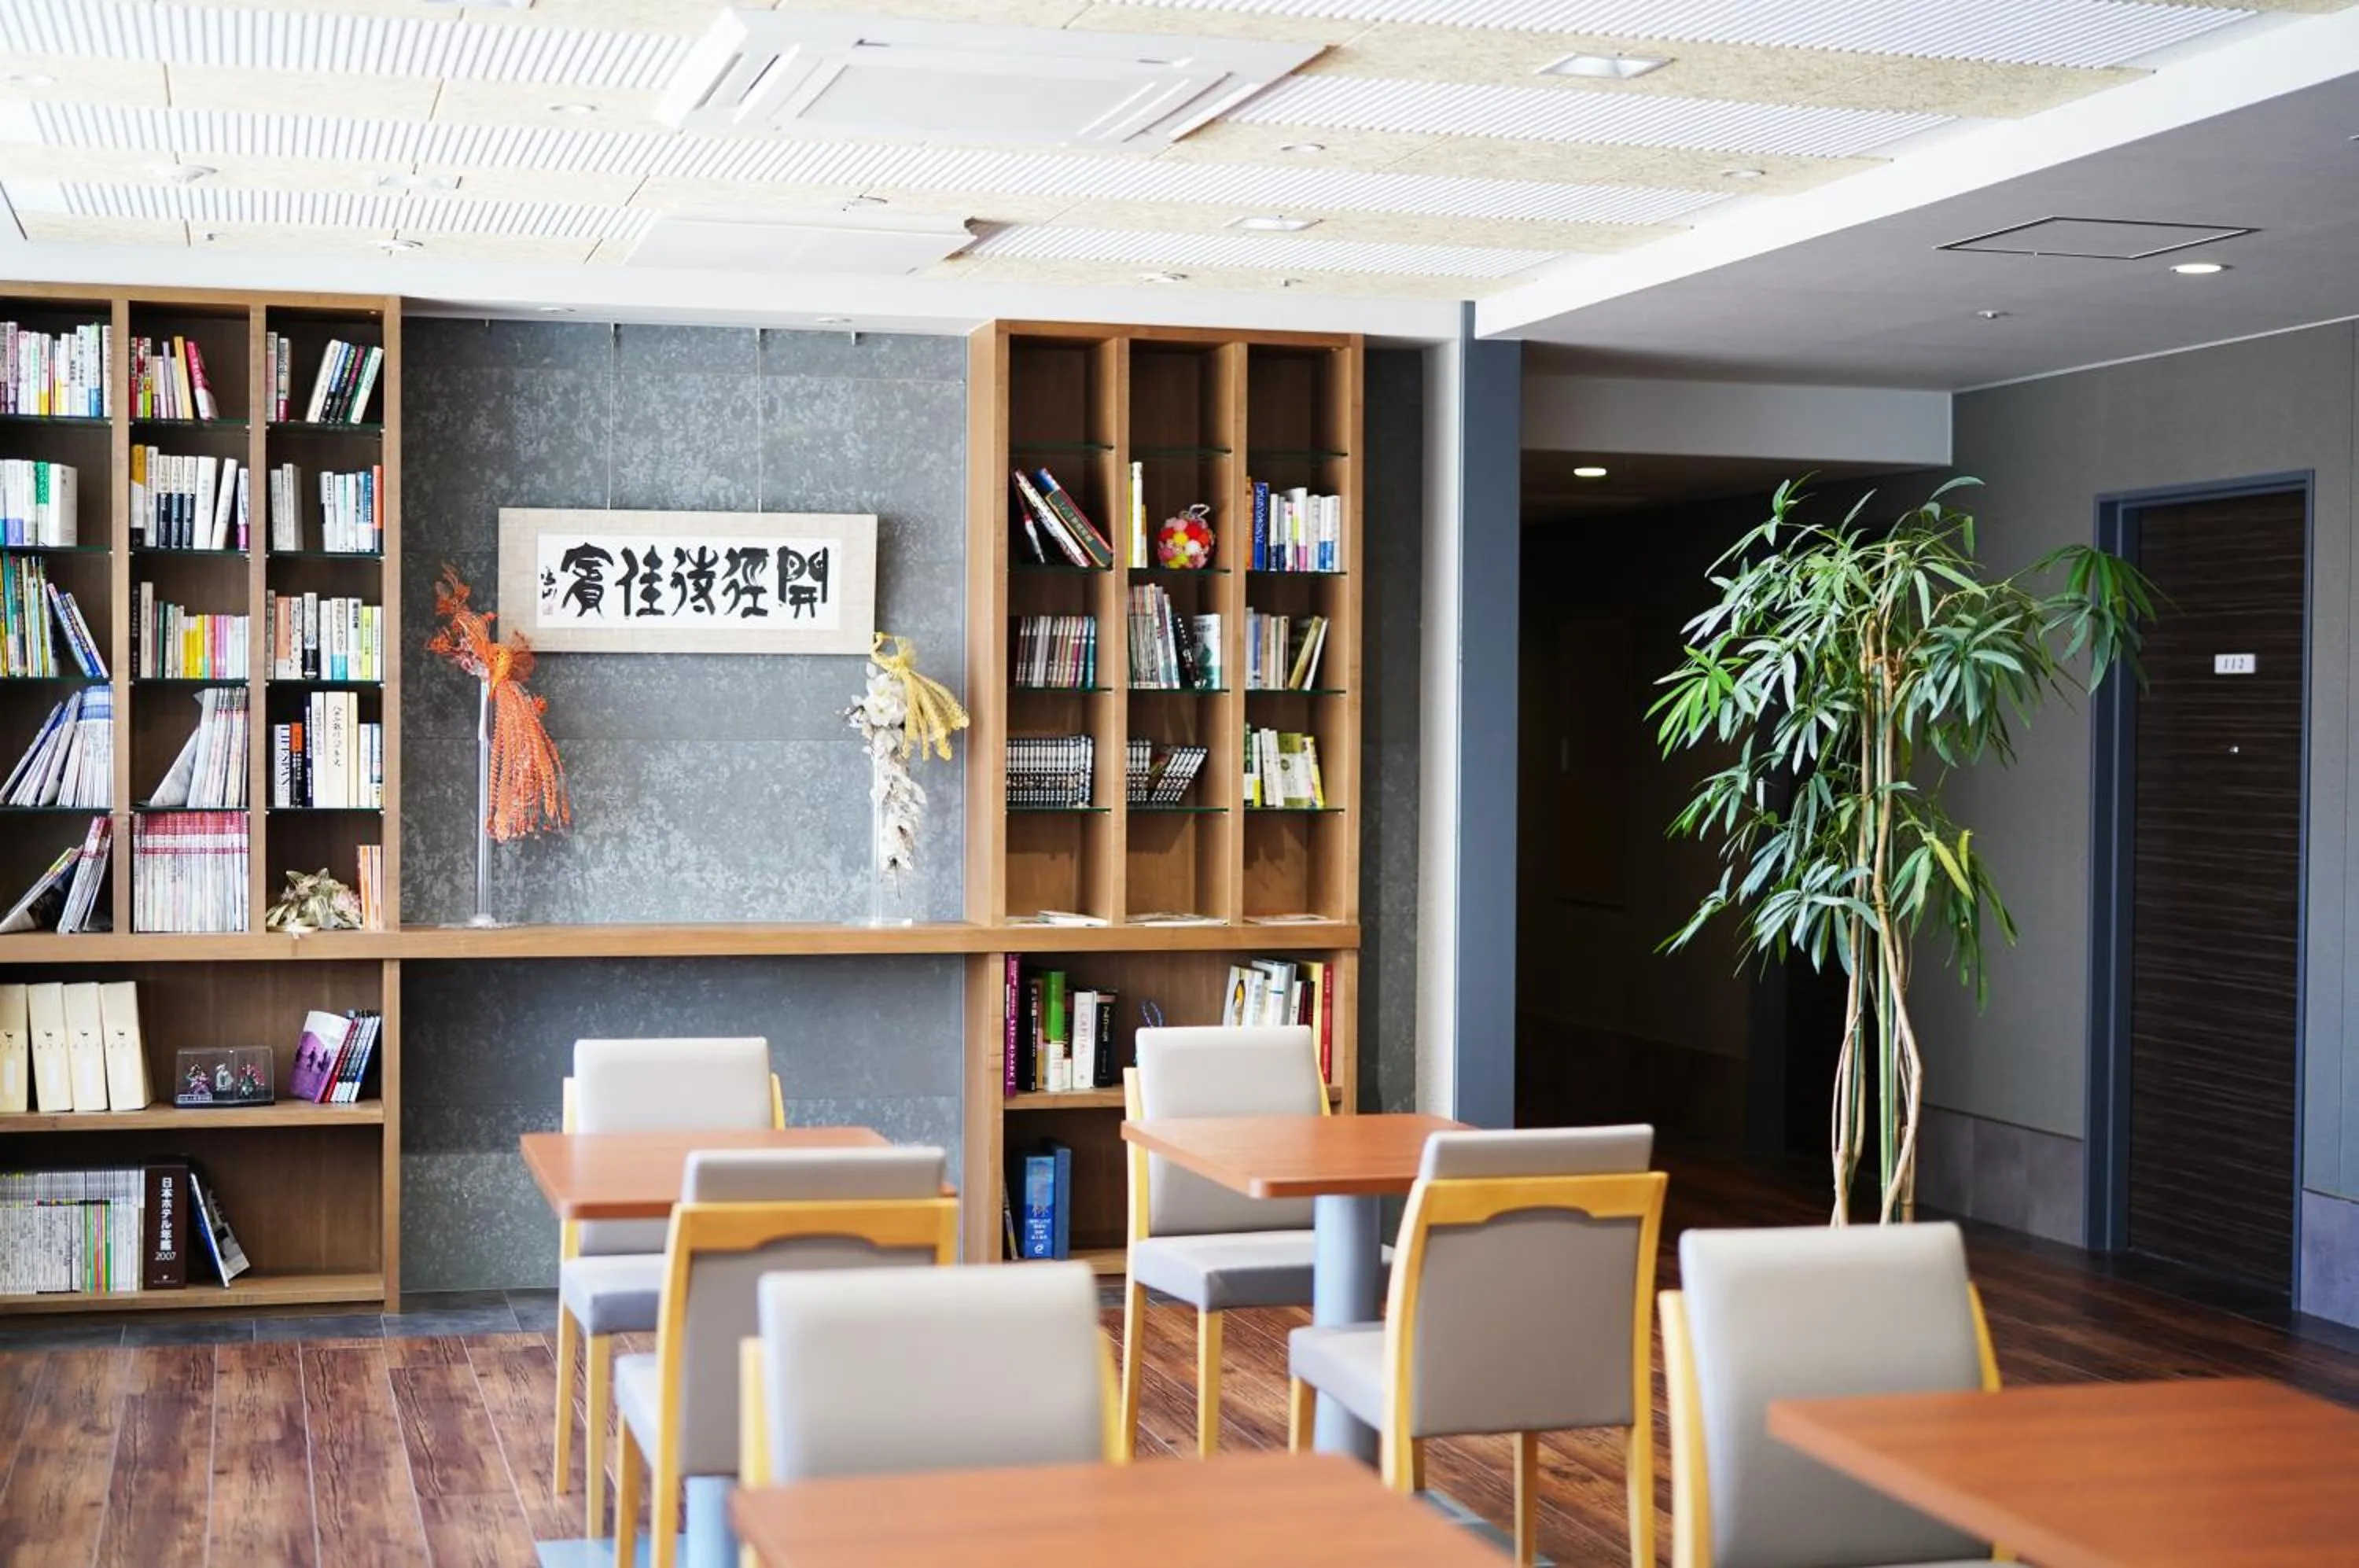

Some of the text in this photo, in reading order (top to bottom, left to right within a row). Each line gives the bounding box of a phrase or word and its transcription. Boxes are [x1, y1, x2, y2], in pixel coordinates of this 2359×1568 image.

[2223, 657, 2245, 670] 112
[160, 1177, 173, 1250] 日本ホテル年鑑
[155, 1251, 177, 1261] 2007
